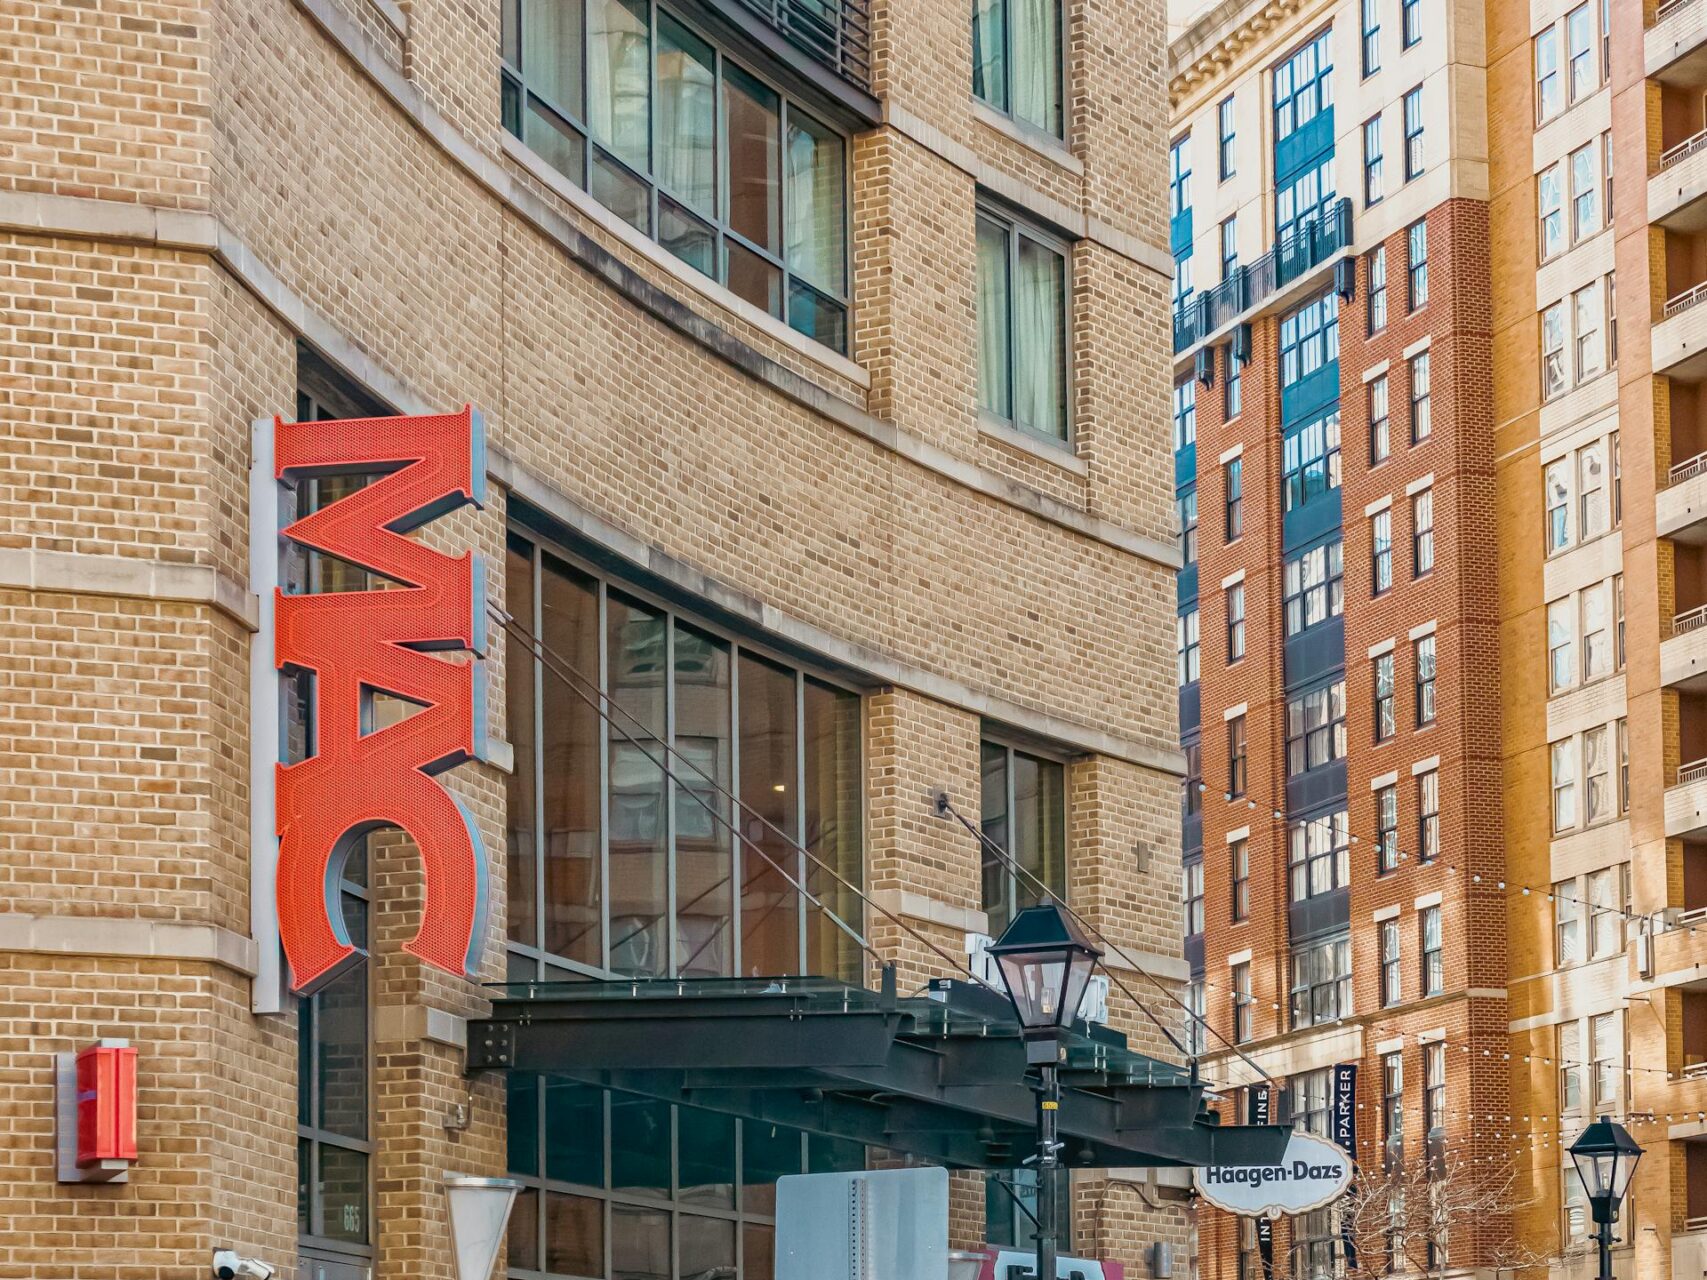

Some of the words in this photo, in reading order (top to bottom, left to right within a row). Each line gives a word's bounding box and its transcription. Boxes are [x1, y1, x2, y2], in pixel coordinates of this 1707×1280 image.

[274, 403, 487, 996] MAC
[1340, 1069, 1351, 1138] PARKER
[1206, 1160, 1342, 1188] Häagen-Dazs
[343, 1204, 360, 1233] 665
